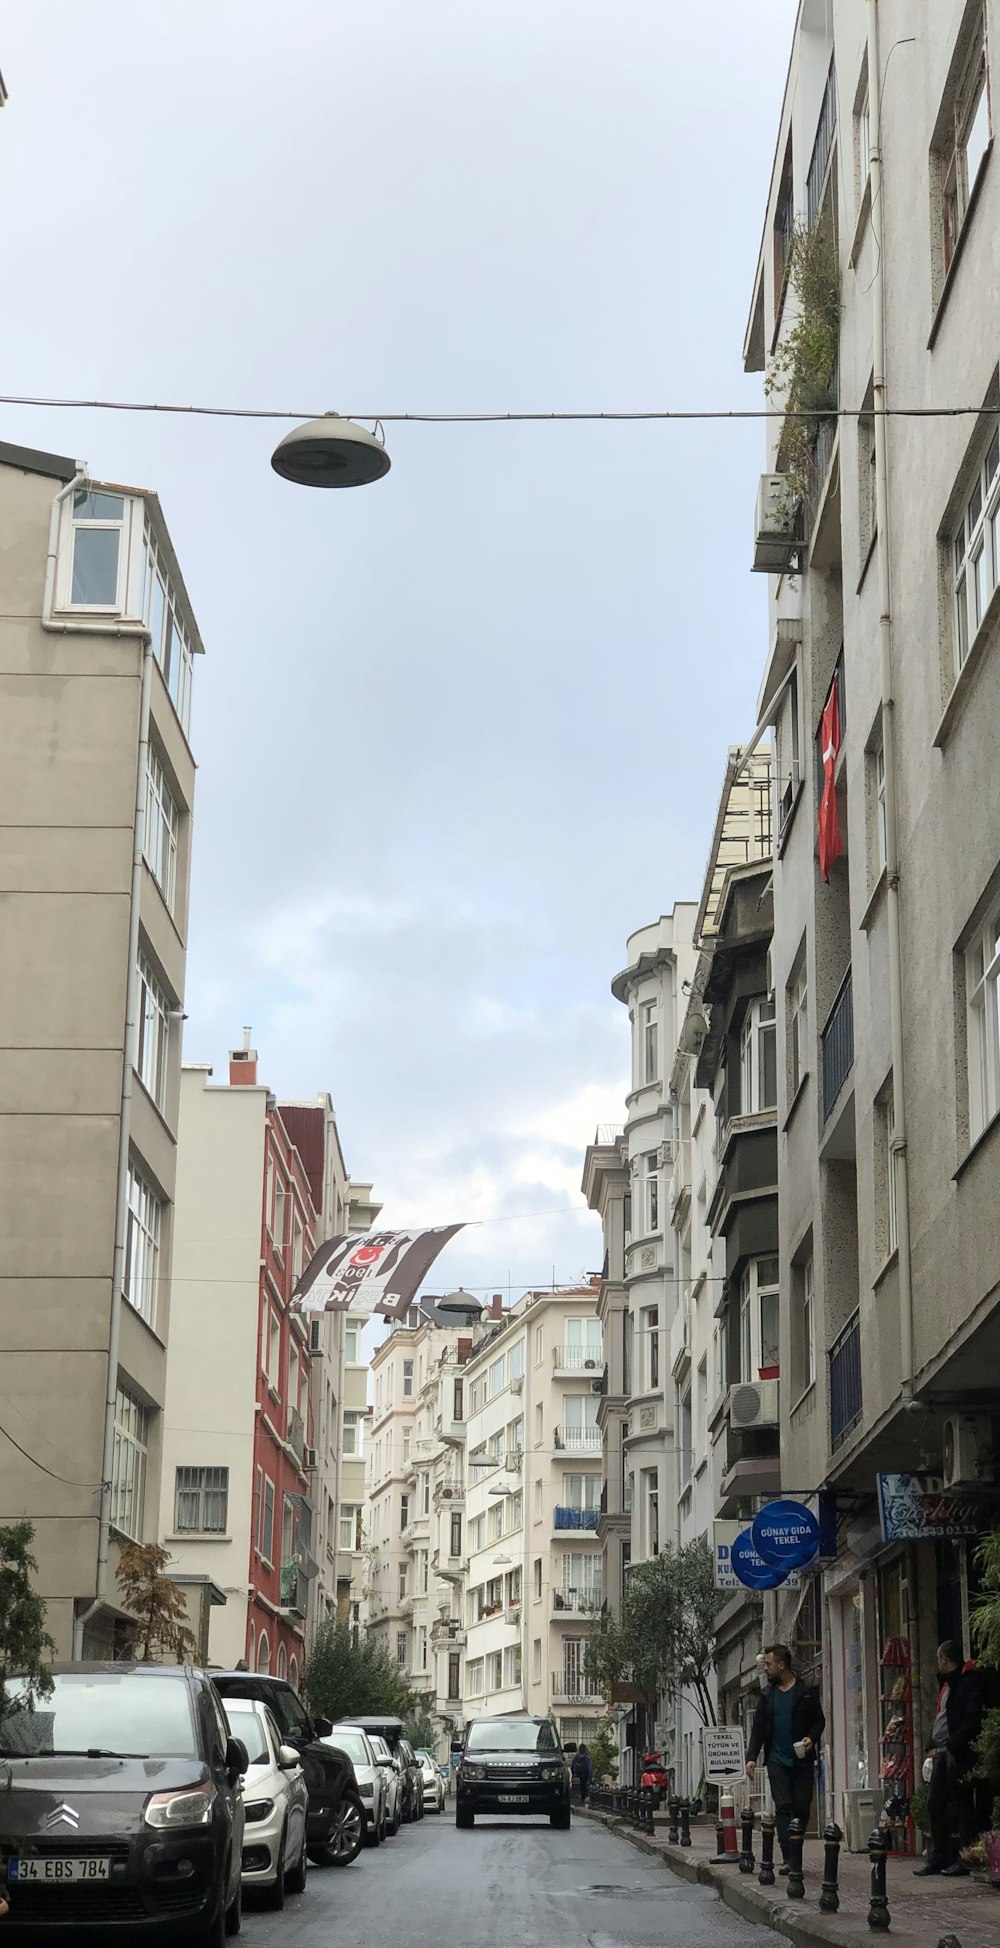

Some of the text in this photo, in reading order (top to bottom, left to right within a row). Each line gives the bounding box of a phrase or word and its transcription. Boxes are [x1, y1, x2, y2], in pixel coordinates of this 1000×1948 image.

[760, 1525, 812, 1538] GÜNAY GIDA
[773, 1536, 801, 1545] TEKEL
[710, 1758, 741, 1766] BULUNUR
[19, 1860, 107, 1878] 34 EBS 784
